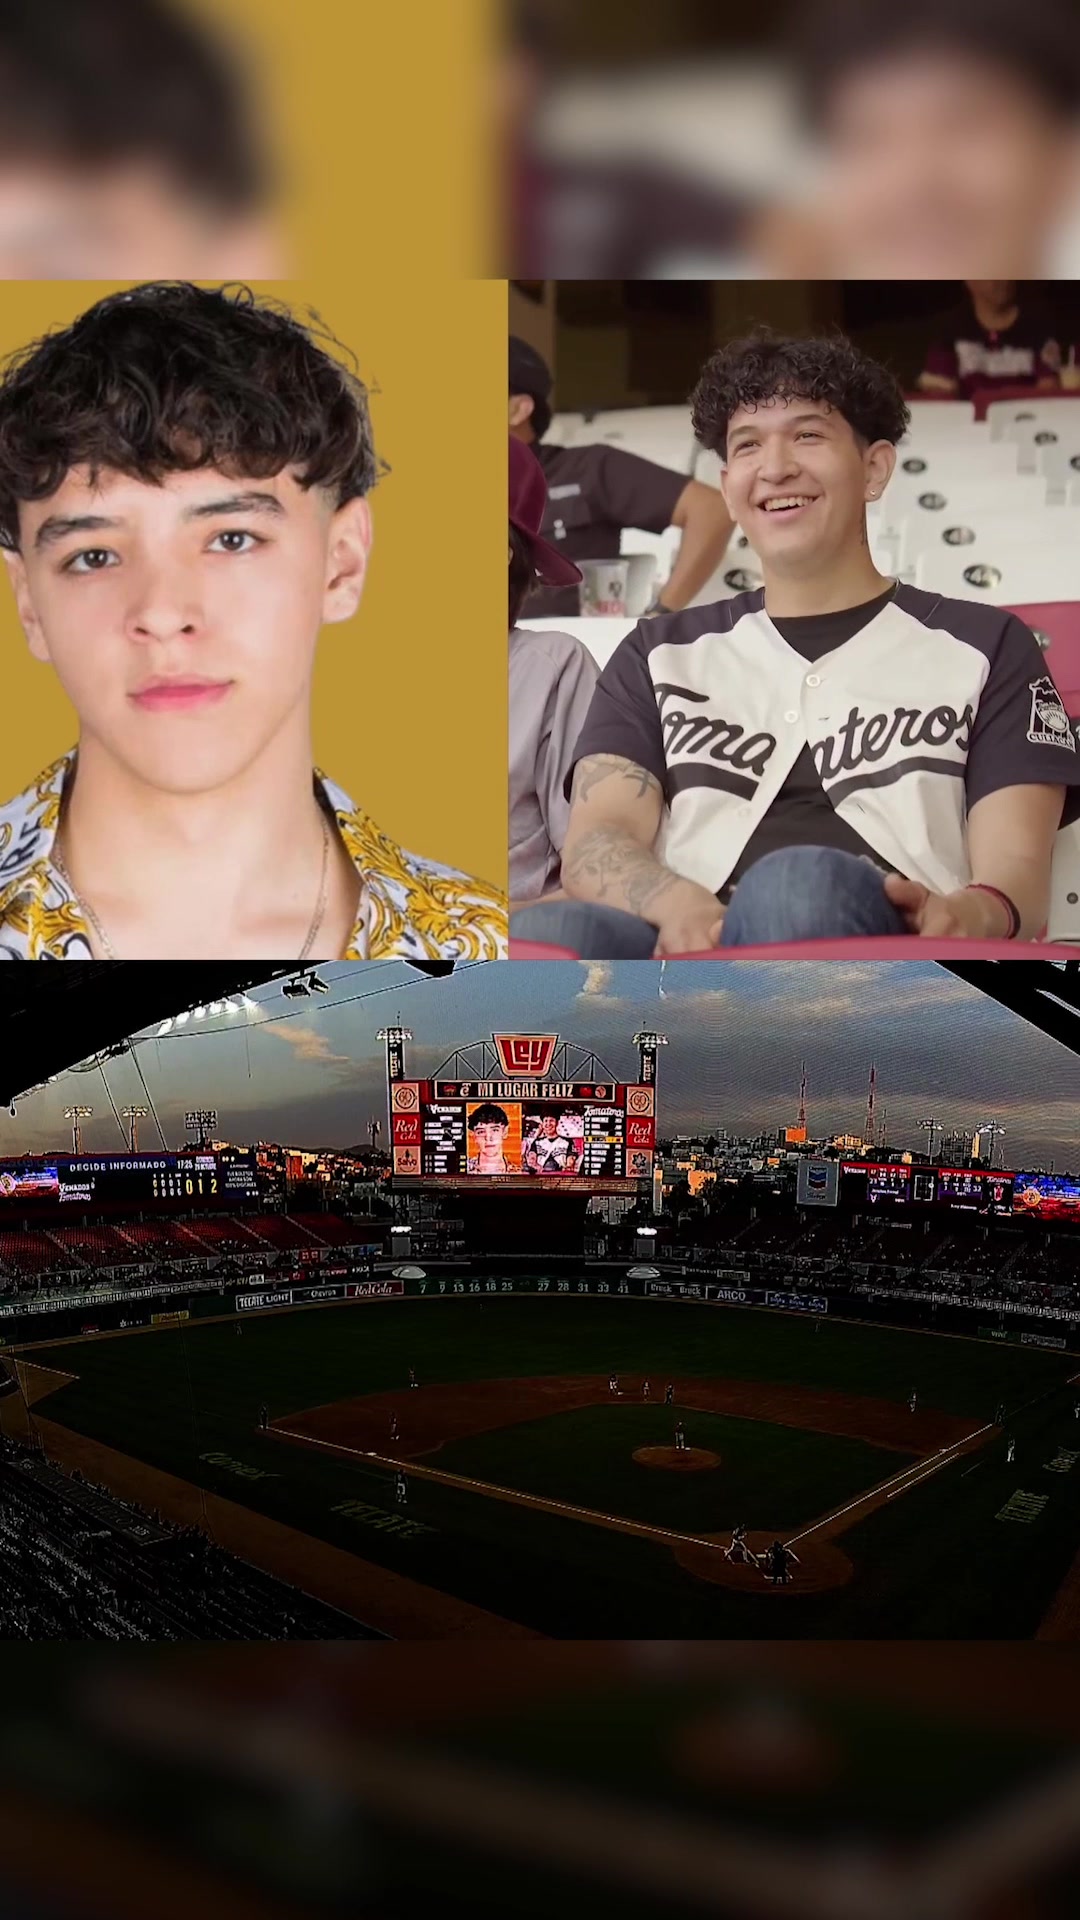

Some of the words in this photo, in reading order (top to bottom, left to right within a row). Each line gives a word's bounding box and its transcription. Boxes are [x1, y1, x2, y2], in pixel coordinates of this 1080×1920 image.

[477, 1083, 493, 1097] MI
[498, 1083, 538, 1097] LUGAR
[542, 1084, 574, 1098] FELIZ
[394, 1119, 418, 1133] Red
[628, 1122, 652, 1136] Red
[400, 1132, 417, 1141] Cola
[69, 1163, 106, 1172] DECIDE
[110, 1161, 166, 1170] INFORMADO
[186, 1178, 193, 1195] 0
[197, 1178, 203, 1194] 1
[210, 1178, 217, 1194] 2
[420, 1285, 426, 1294] 7
[440, 1284, 446, 1294] 9
[453, 1284, 464, 1293] 13
[469, 1284, 480, 1293] 16
[485, 1283, 496, 1292] 18
[501, 1283, 513, 1292] 25
[537, 1283, 549, 1292] 27
[557, 1283, 570, 1292] 28
[577, 1283, 589, 1293] 31
[597, 1284, 609, 1293] 33
[717, 1290, 746, 1301] ARCO
[239, 1296, 265, 1308] TECATE
[266, 1293, 289, 1304] LIGHT
